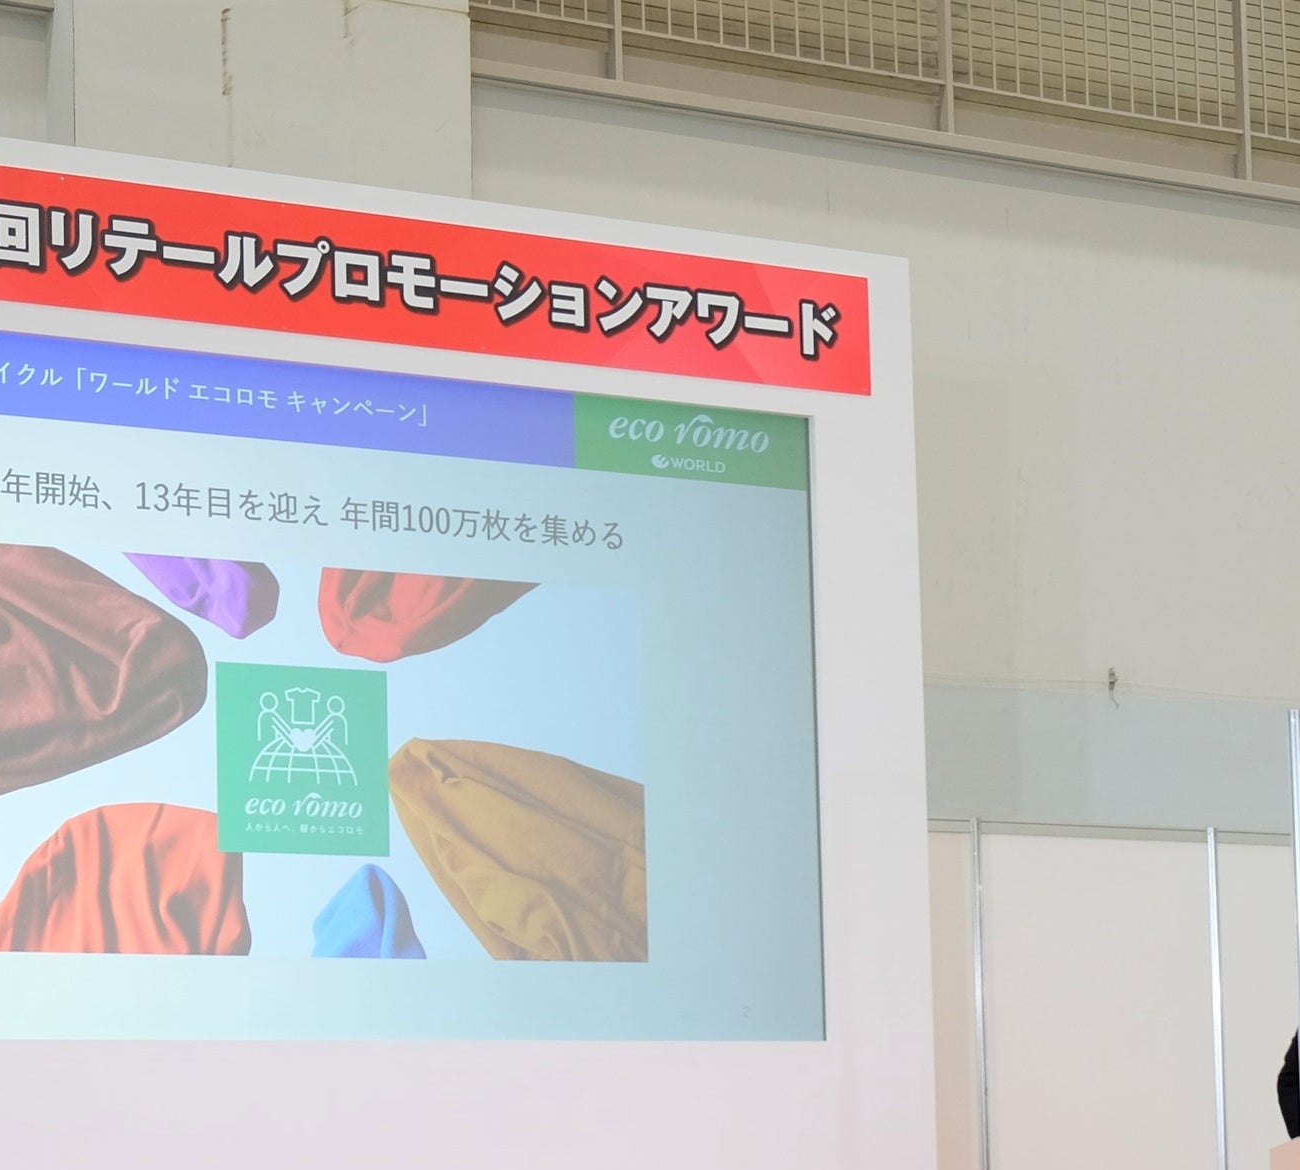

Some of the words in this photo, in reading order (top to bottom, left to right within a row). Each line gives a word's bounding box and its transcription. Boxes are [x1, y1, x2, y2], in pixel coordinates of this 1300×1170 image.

[188, 384, 278, 409] エコロモ
[286, 389, 428, 427] キャンペーン」
[608, 416, 666, 442] eco
[670, 456, 726, 473] WORLD
[340, 496, 624, 550] 年間100万枚を集める
[244, 797, 286, 816] eco
